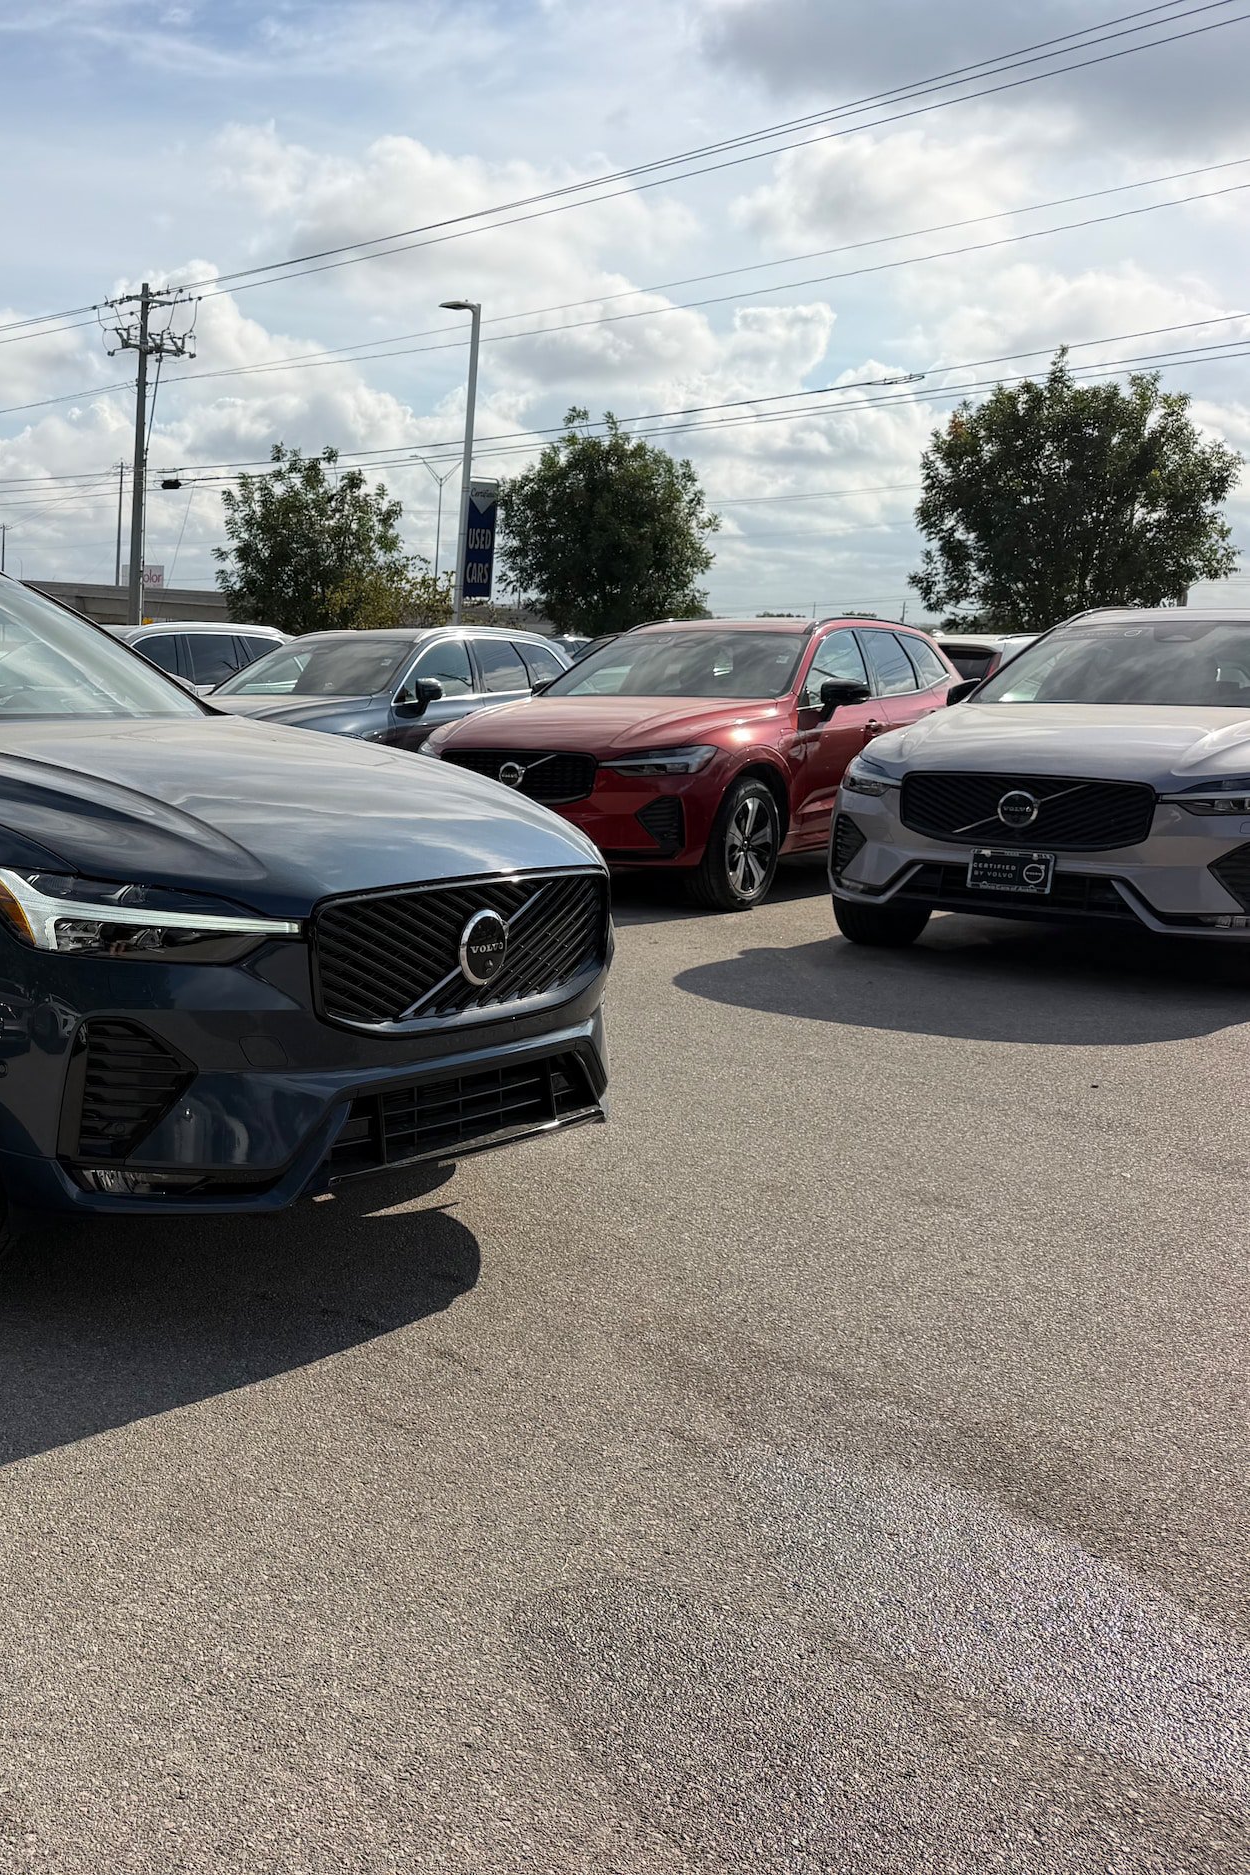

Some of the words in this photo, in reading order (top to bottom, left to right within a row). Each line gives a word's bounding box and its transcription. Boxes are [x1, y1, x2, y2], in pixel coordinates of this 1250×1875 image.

[468, 528, 491, 550] USED
[142, 569, 162, 583] olor
[466, 562, 489, 584] CARS
[973, 862, 1016, 870] CERTIFIED
[987, 871, 1014, 879] VOLVO
[470, 941, 504, 954] VOLVO
